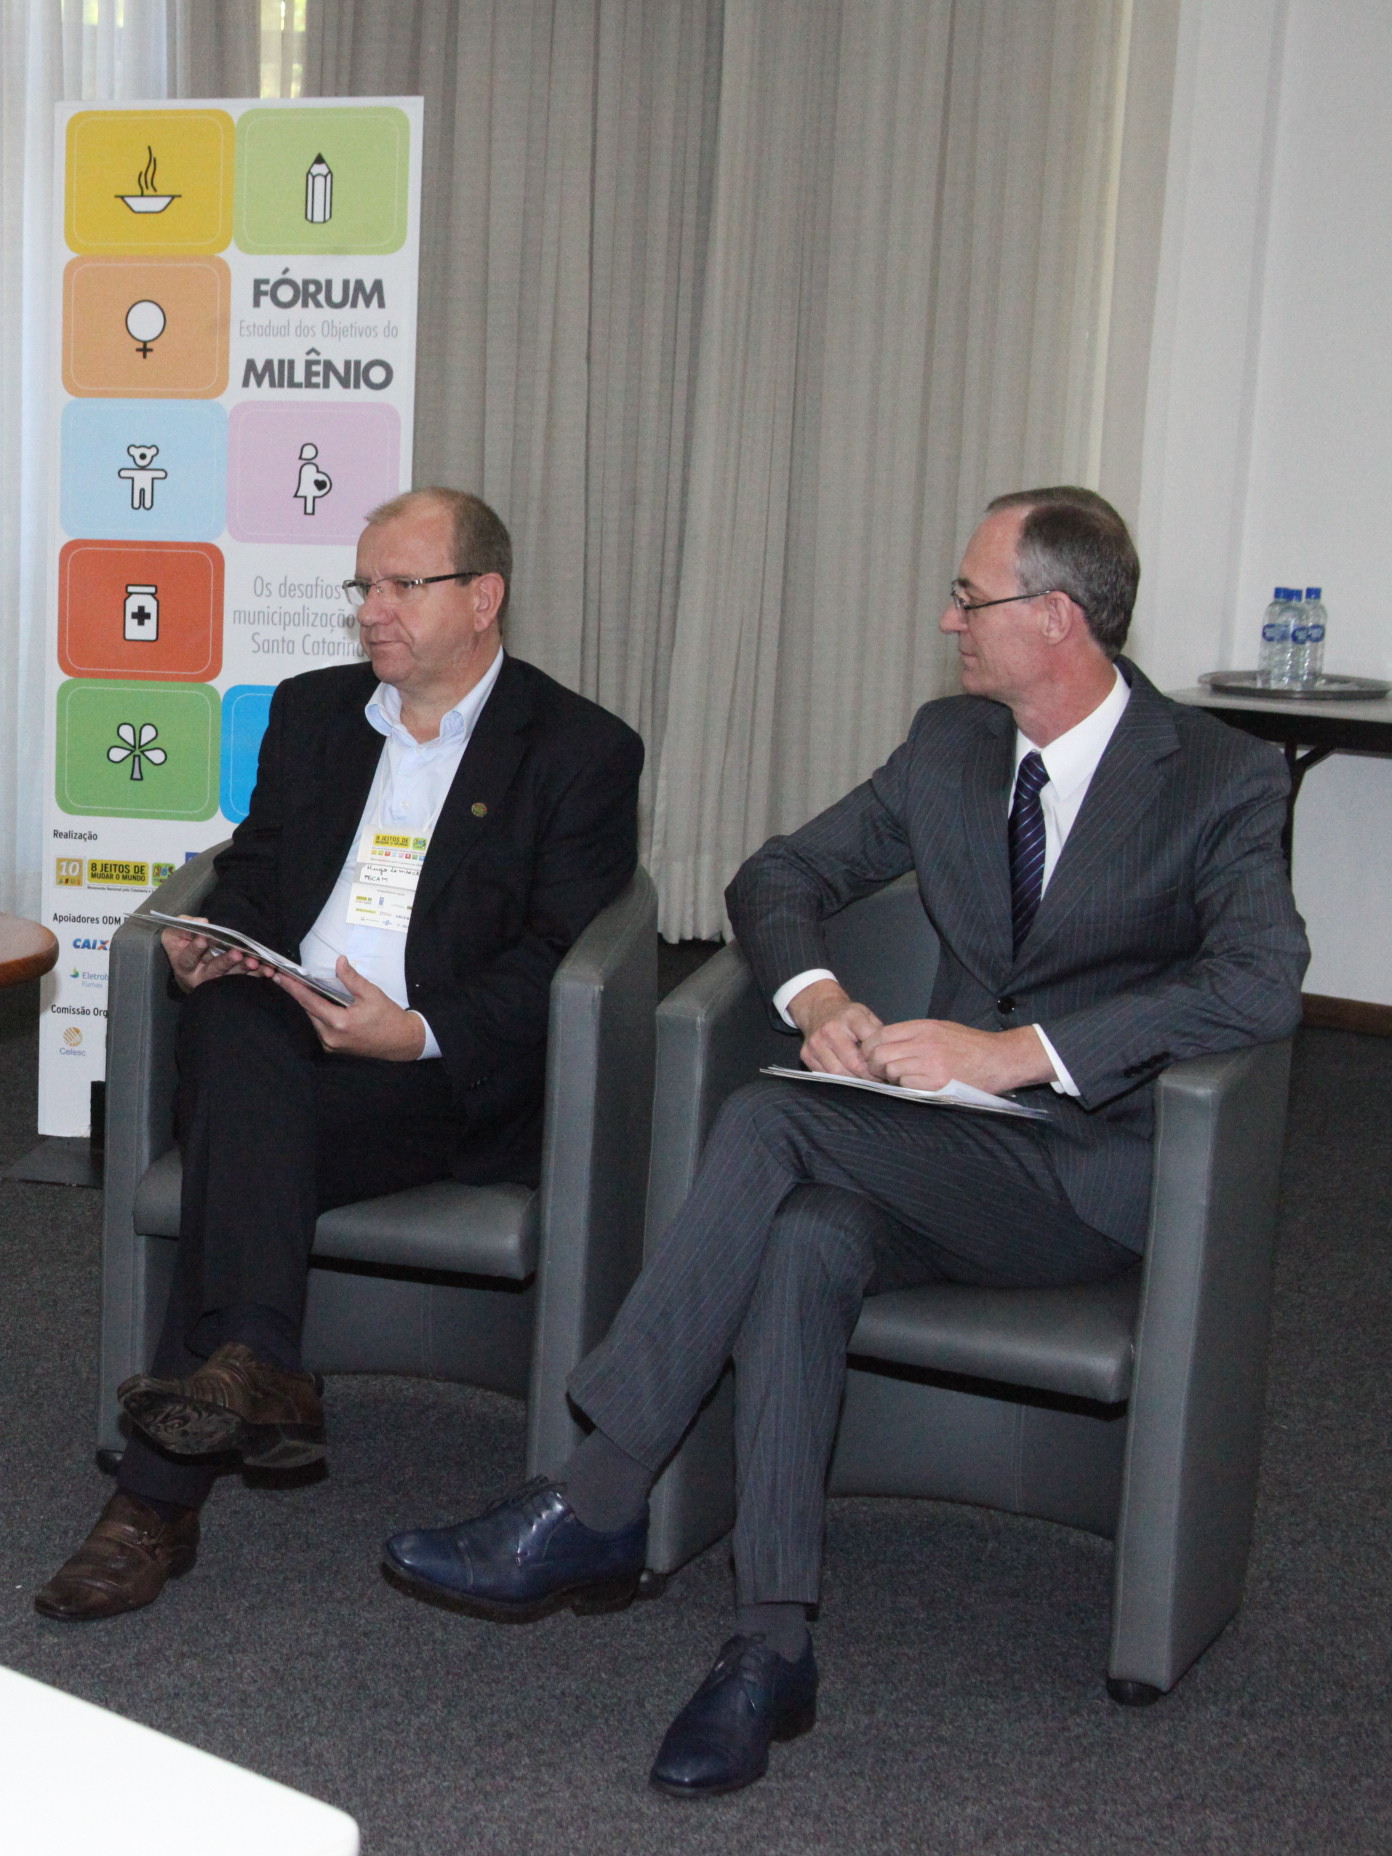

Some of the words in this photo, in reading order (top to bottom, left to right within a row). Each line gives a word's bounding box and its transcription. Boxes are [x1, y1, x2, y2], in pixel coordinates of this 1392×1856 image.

[252, 266, 386, 309] FÓRUM
[238, 319, 291, 338] Estadual
[294, 319, 317, 338] dos
[321, 319, 379, 342] Objetivos
[383, 320, 399, 339] do
[241, 346, 394, 391] MILÊNIO
[253, 575, 273, 598] Os
[278, 575, 342, 600] desafios
[233, 604, 356, 634] municipalização
[251, 631, 295, 655] Santa
[53, 829, 98, 842] Realização
[59, 860, 80, 876] 10
[90, 862, 98, 872] 8
[100, 863, 131, 875] JEITOS
[133, 864, 146, 875] DE
[90, 871, 114, 880] MUDAR
[122, 873, 146, 882] MUNDO
[52, 912, 100, 925] Apoiadores
[102, 915, 121, 926] ODM
[72, 937, 110, 951] CAIX
[51, 1004, 91, 1016] Comissão
